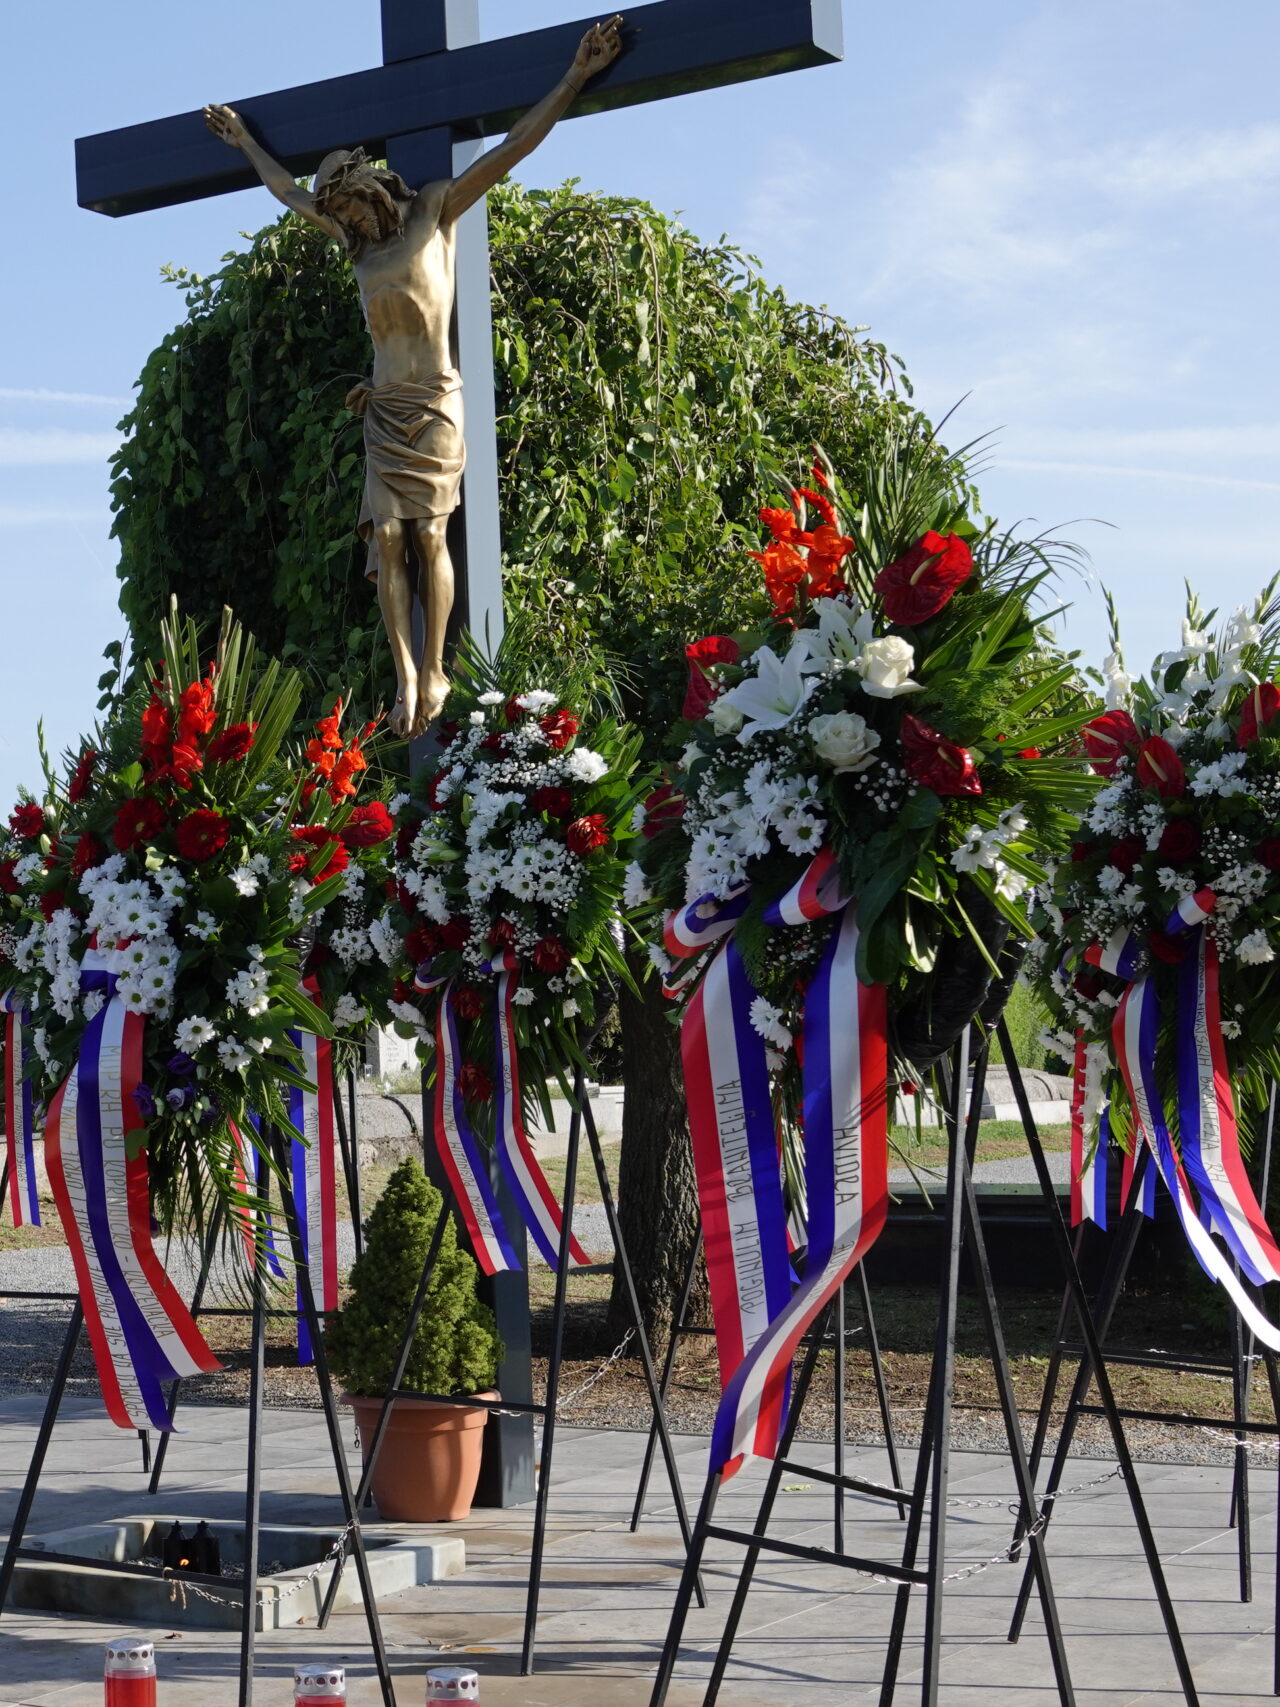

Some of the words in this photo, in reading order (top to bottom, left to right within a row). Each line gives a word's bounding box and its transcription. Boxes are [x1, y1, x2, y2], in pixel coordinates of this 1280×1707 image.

[100, 1045, 120, 1082] MUP
[100, 1089, 120, 1112] RH
[1194, 1002, 1210, 1066] HRVATSKIH
[1209, 1161, 1229, 1183] RH
[102, 1126, 123, 1150] PU
[61, 1151, 82, 1189] UMRLE
[450, 1141, 475, 1187] POGINULIM
[833, 1127, 861, 1207] HVIDRA
[470, 1195, 491, 1228] SPOMEN
[733, 1221, 765, 1314] POGINULIM
[107, 1326, 126, 1346] SVE
[112, 1353, 132, 1369] NA
[117, 1374, 148, 1418] SPOMEN
